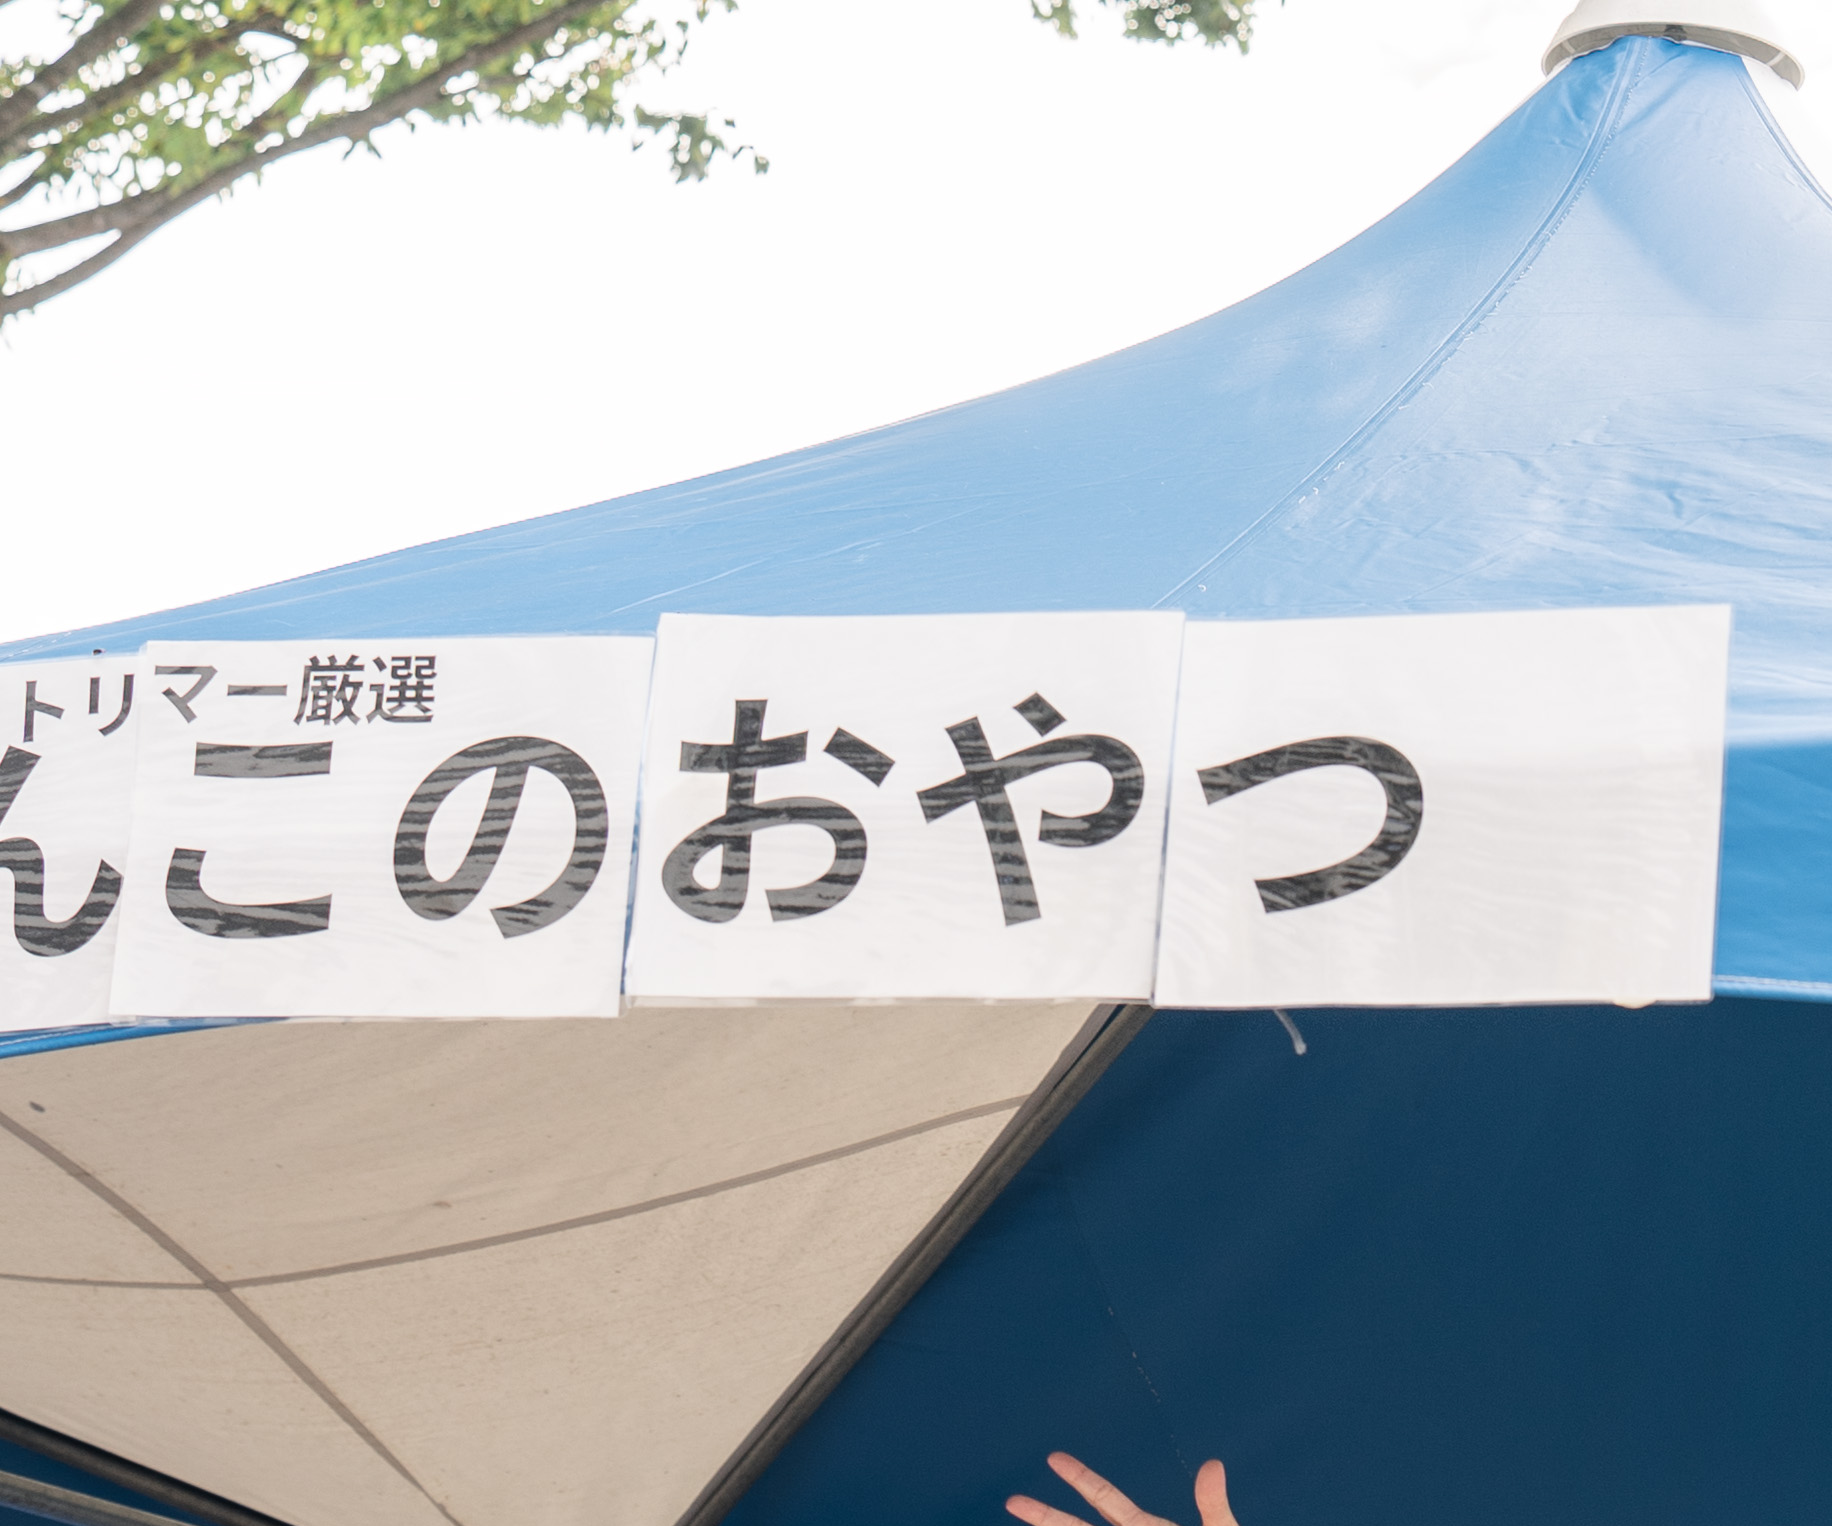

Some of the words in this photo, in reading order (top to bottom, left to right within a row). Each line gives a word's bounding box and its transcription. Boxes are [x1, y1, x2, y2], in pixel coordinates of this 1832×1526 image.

[23, 654, 438, 743] トリマー厳選
[0, 692, 1423, 957] んこのおやつ
